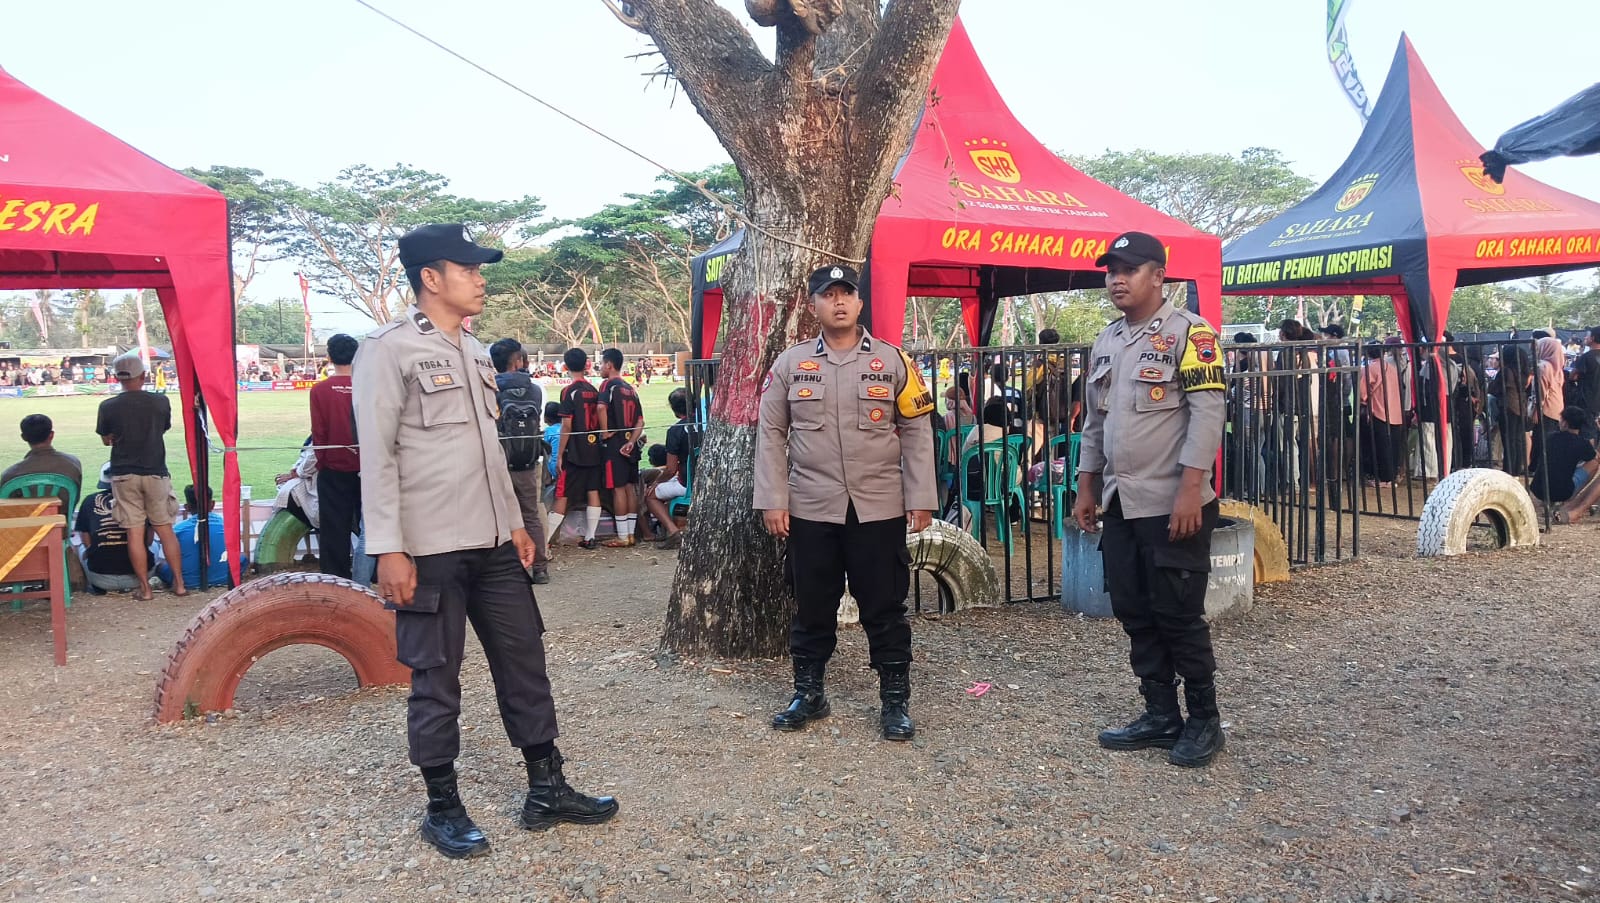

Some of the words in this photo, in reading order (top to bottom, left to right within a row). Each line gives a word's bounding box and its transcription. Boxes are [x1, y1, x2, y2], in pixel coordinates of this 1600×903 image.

[977, 156, 1016, 178] SHR
[958, 181, 1088, 208] SAHARA
[0, 198, 99, 235] ESRA
[1064, 209, 1109, 218] TANGAN
[1278, 211, 1374, 239] SAHARA
[942, 227, 981, 251] ORA
[990, 231, 1065, 257] SAHARA
[1069, 238, 1106, 259] ORA
[1476, 239, 1505, 258] ORA
[1509, 237, 1562, 256] SAHARA
[1566, 236, 1592, 254] ORA
[1222, 265, 1235, 286] TU
[1236, 260, 1281, 285] BATANG
[1282, 255, 1325, 280] PENUH
[1325, 245, 1393, 276] INSPIRASI
[1139, 352, 1173, 364] POLRI
[793, 373, 822, 383] WISNU
[861, 373, 893, 383] POLRI
[1210, 552, 1245, 568] TEMPAT
